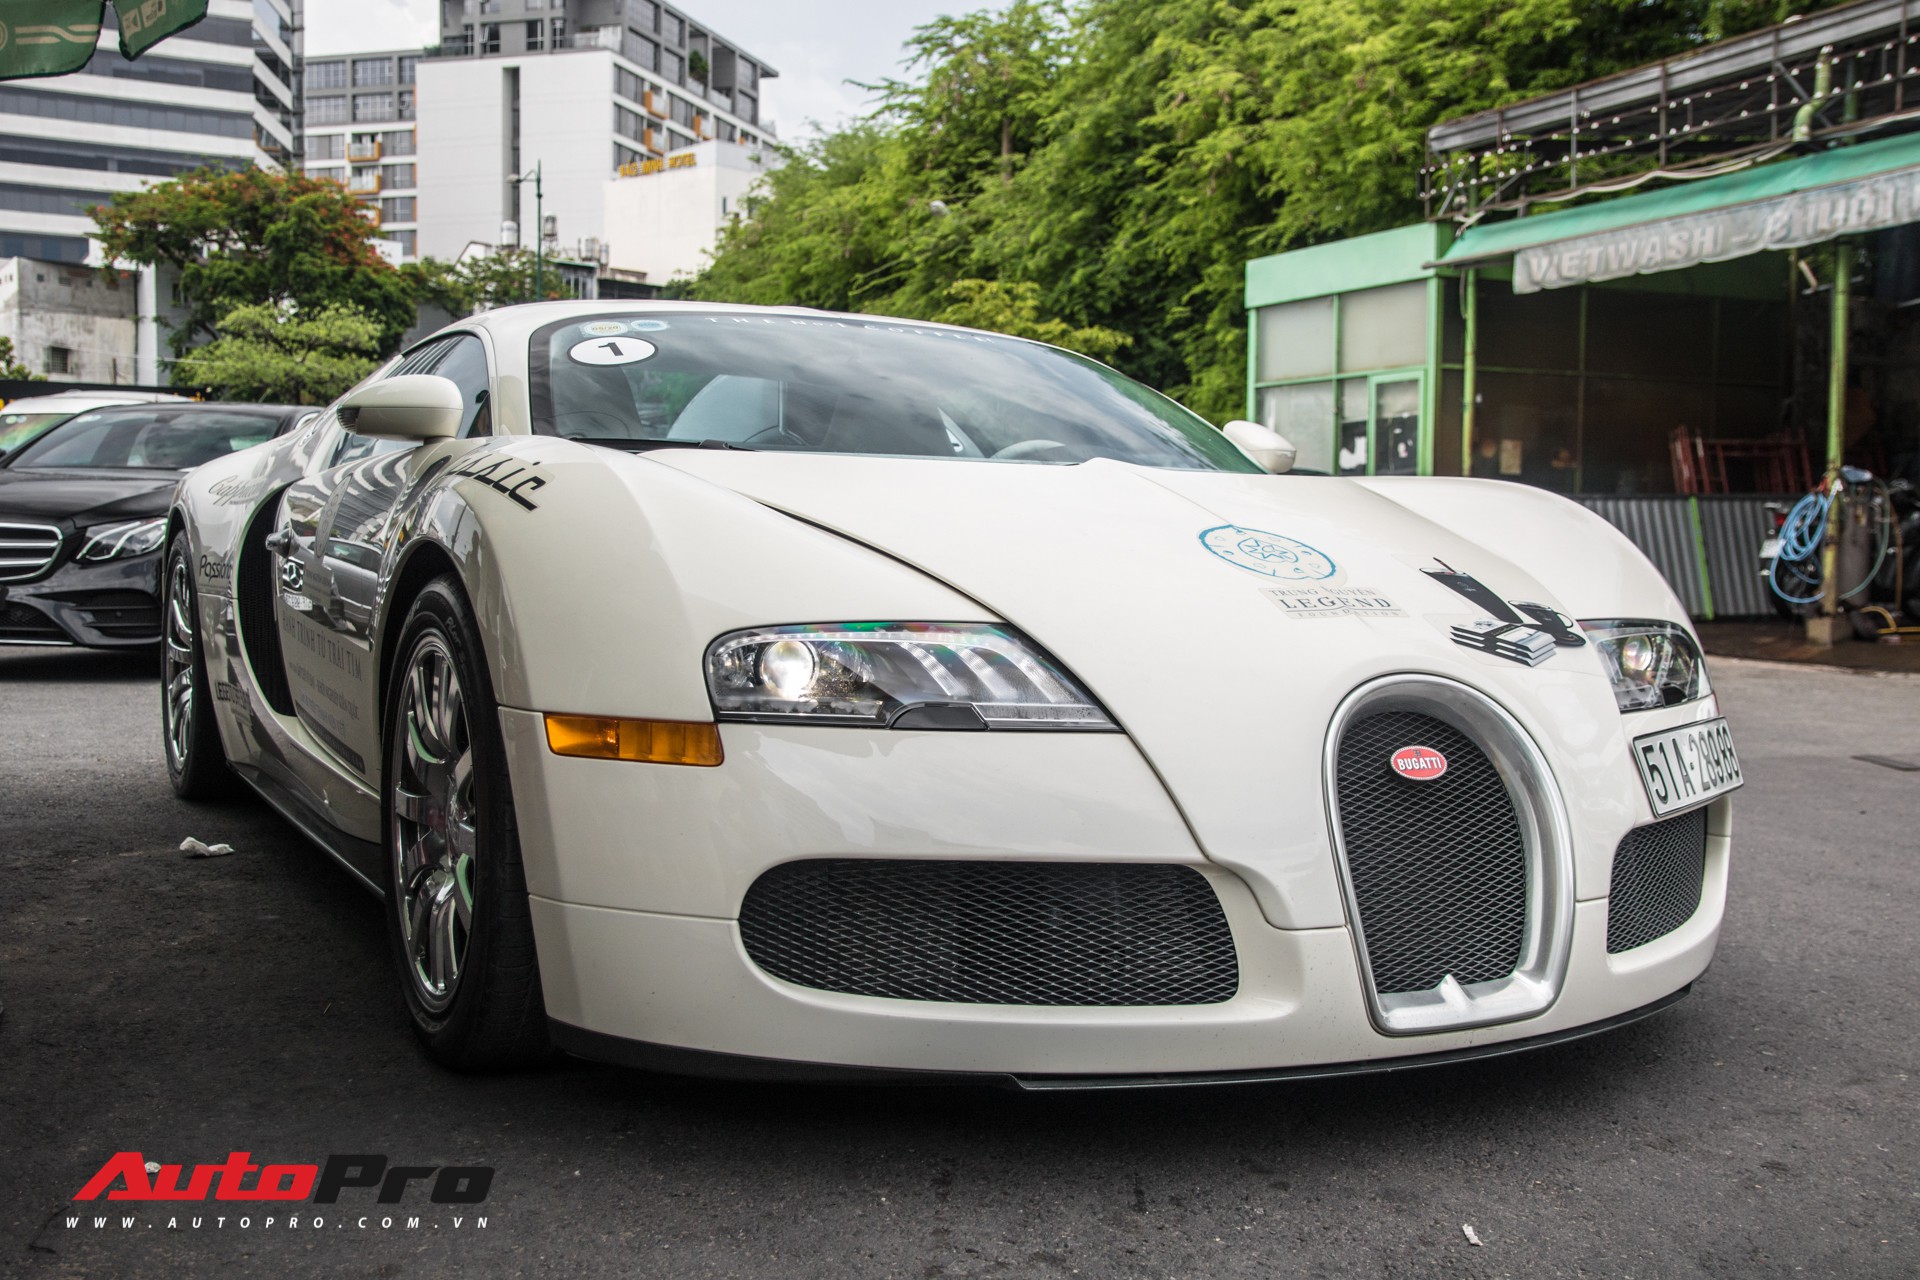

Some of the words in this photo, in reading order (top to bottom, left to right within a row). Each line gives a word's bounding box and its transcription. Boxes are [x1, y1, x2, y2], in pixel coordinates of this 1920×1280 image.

[598, 341, 624, 357] 1
[1269, 588, 1319, 597] TRUNG
[1279, 596, 1392, 610] LEGEND
[1397, 757, 1442, 771] BUGATTI
